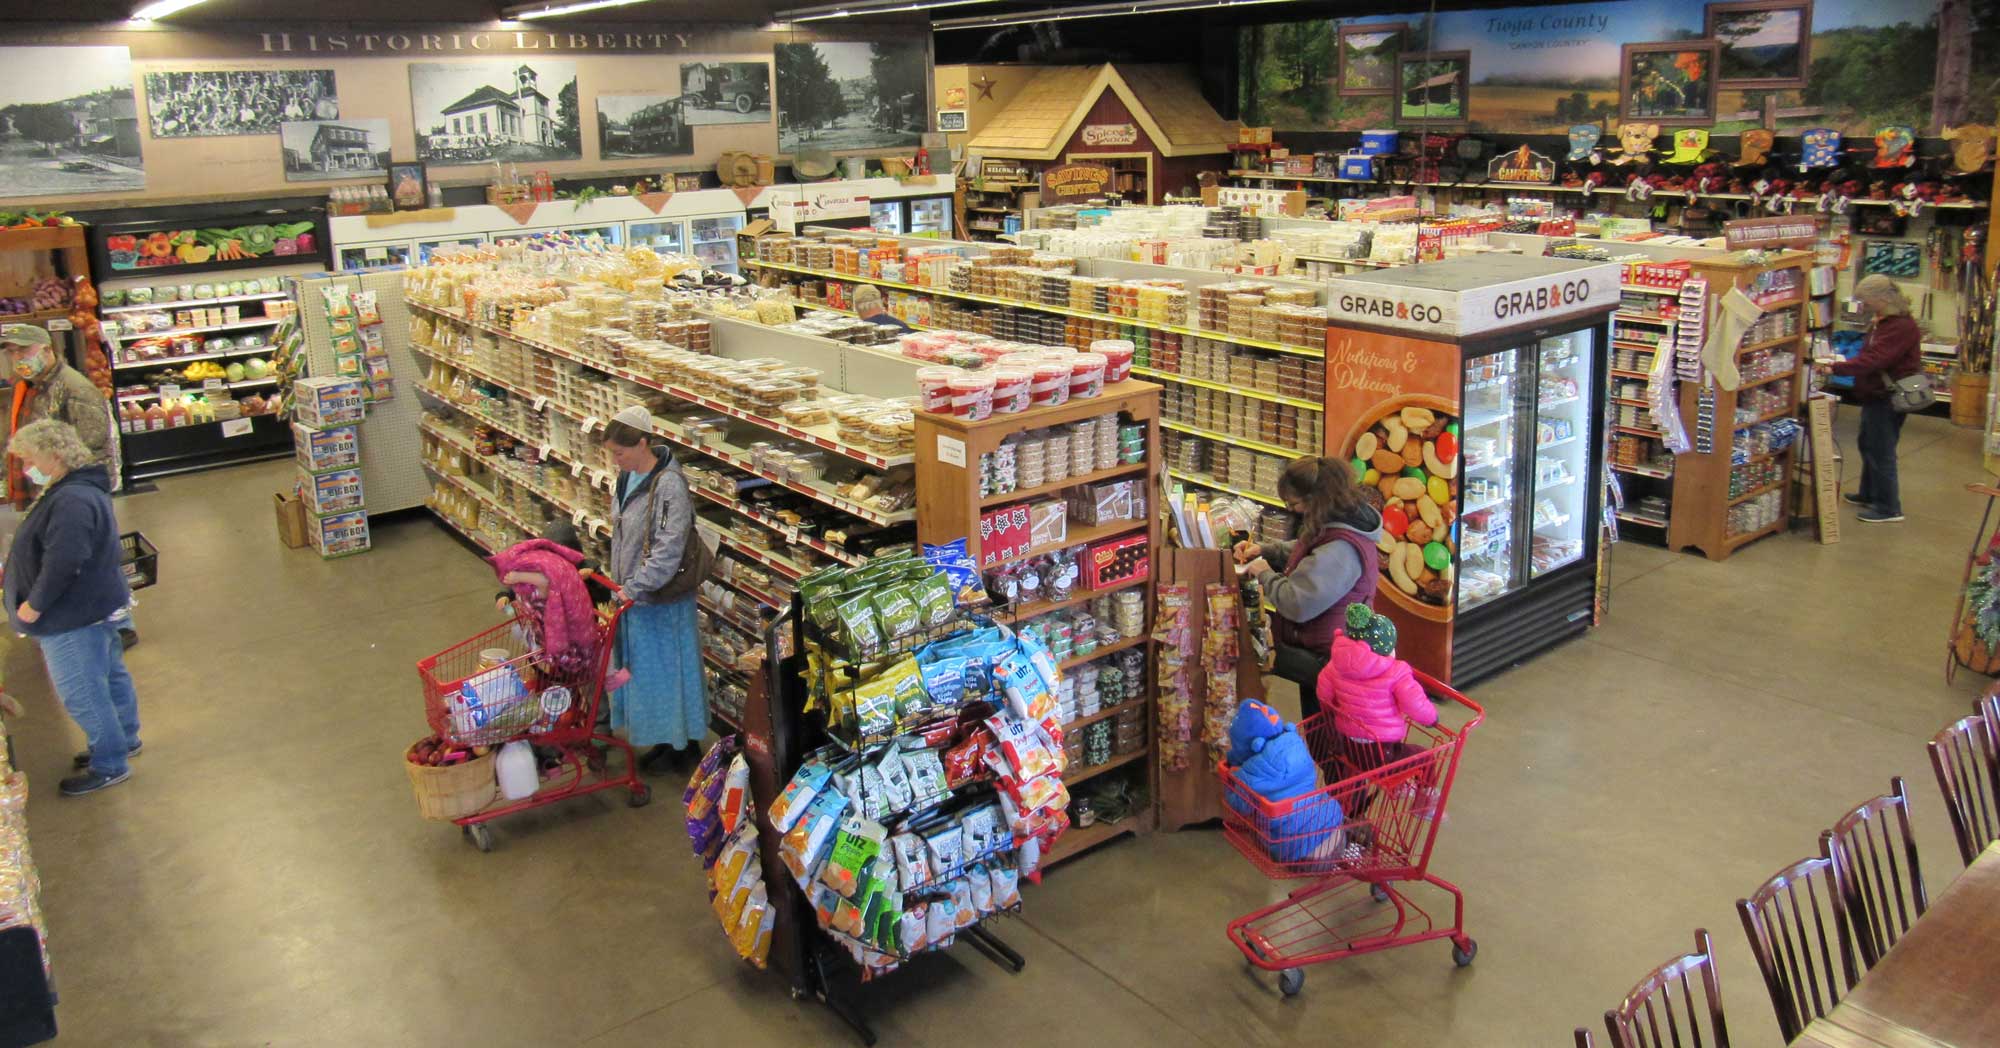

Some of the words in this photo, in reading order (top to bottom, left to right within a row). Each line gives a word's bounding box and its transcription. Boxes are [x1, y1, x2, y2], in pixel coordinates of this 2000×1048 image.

[1487, 18, 1536, 37] Tioga
[1540, 13, 1609, 33] County
[260, 32, 496, 51] HISTORIC
[512, 32, 693, 49] LIBERTY
[1046, 166, 1109, 190] SAVINGS
[1498, 167, 1543, 181] CAMPFIRE
[1055, 182, 1101, 197] CENTER
[1494, 278, 1590, 319] GRAB&GO
[1340, 295, 1443, 324] GRAB&GO
[1327, 337, 1399, 374] Nutritious
[1402, 351, 1417, 374] &
[1333, 362, 1402, 398] Delicious
[331, 400, 345, 409] BIG
[345, 397, 360, 407] BOX
[321, 445, 338, 454] BIG
[338, 442, 353, 452] BOX
[343, 485, 360, 494] BOX
[349, 526, 365, 536] BOX
